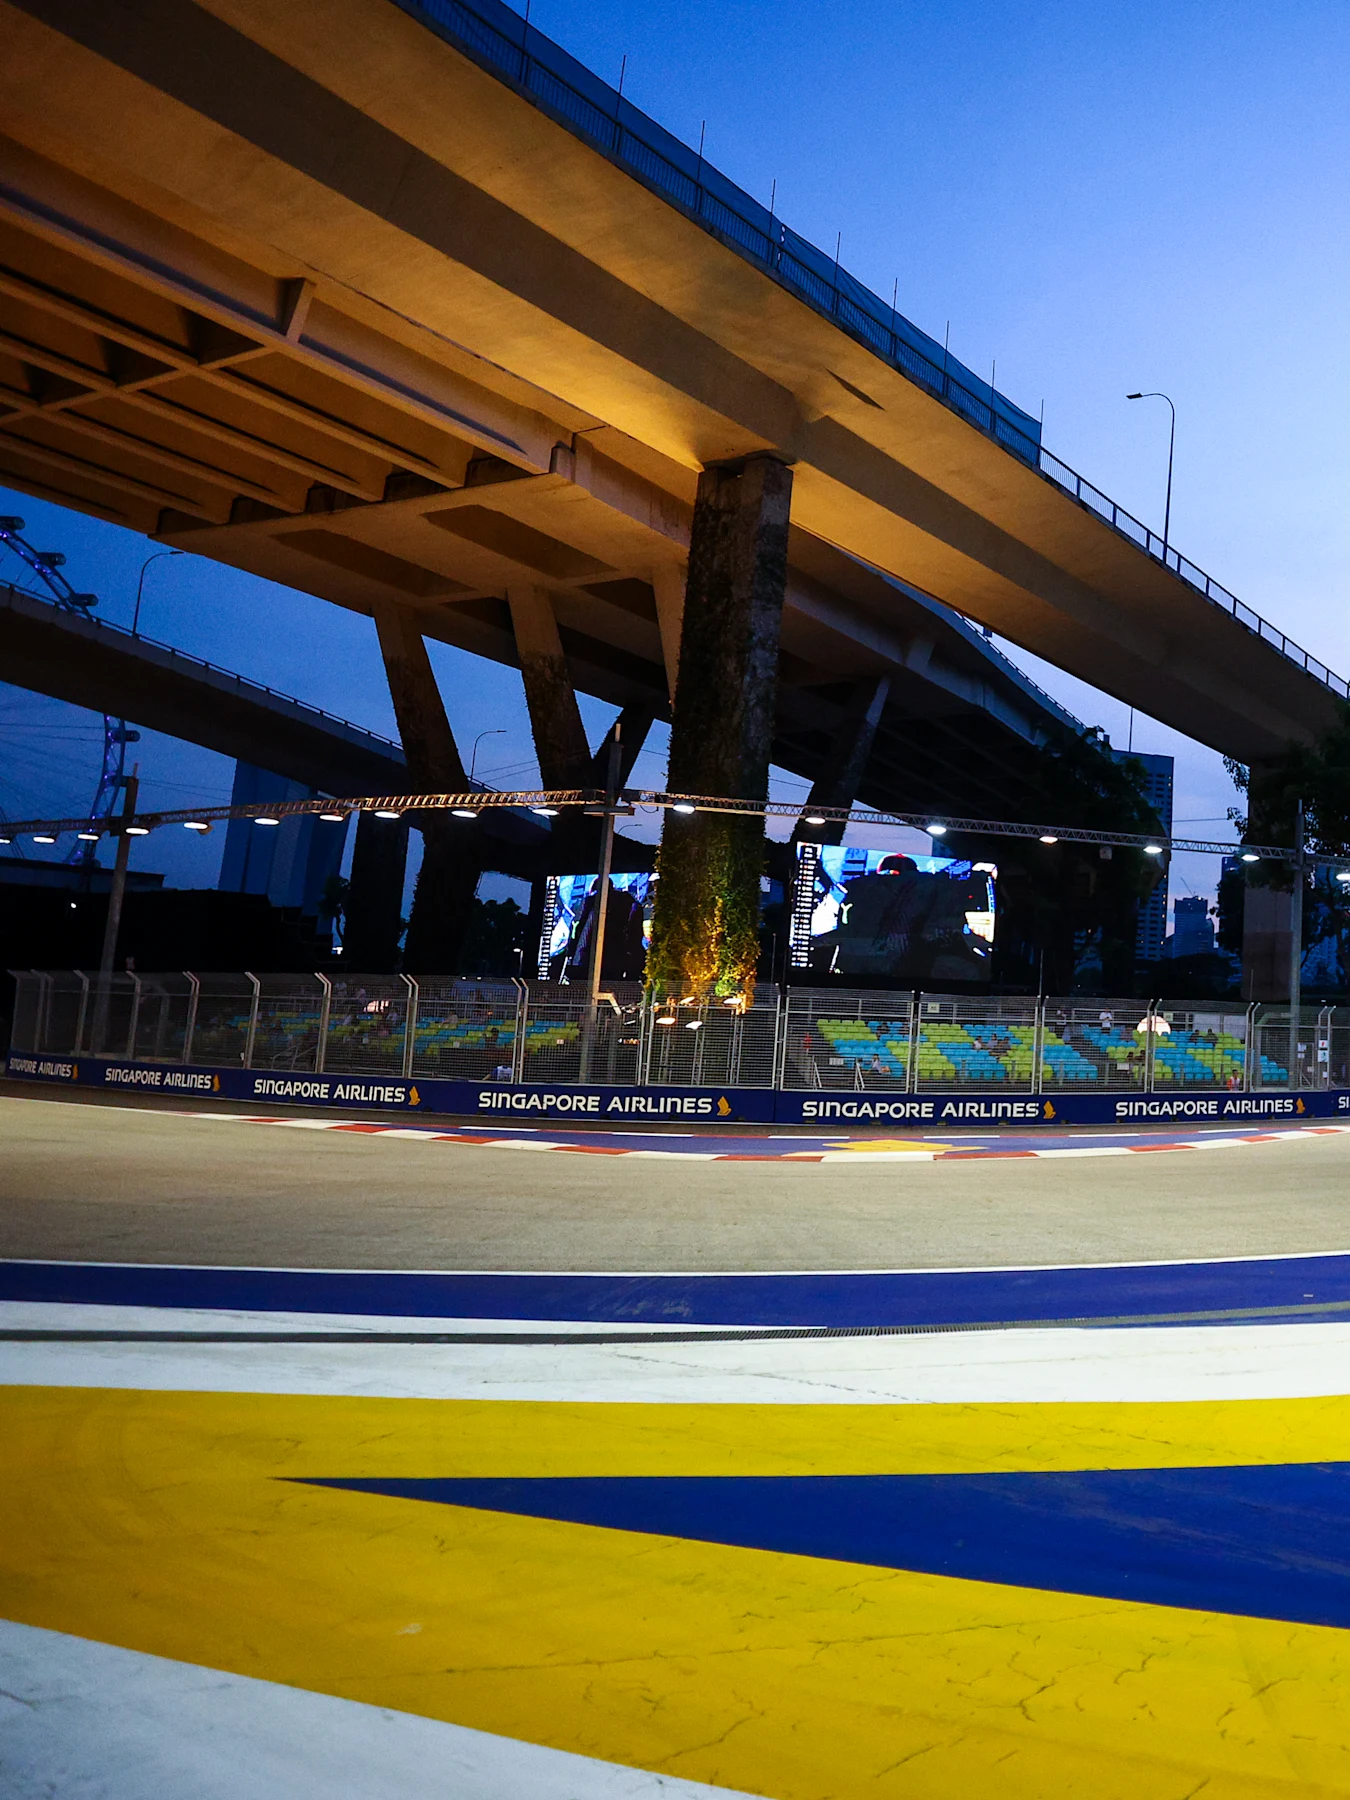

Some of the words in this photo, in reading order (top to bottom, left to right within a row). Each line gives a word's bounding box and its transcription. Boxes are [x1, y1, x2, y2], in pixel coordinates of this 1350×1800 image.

[37, 1061, 73, 1078] AIRLINES
[104, 1067, 161, 1086] SINGAPORE
[162, 1072, 212, 1090] AIRLINES
[253, 1078, 329, 1099] SINGAPORE
[332, 1083, 406, 1103] AIRLINES
[478, 1091, 600, 1112] SINGAPORE
[606, 1096, 713, 1114] AIRLINES
[801, 1100, 934, 1119] SINGAPORE
[940, 1101, 1040, 1118] AIRLINES
[1115, 1100, 1218, 1117] SINGAPORE
[1222, 1098, 1294, 1114] AIRLINES
